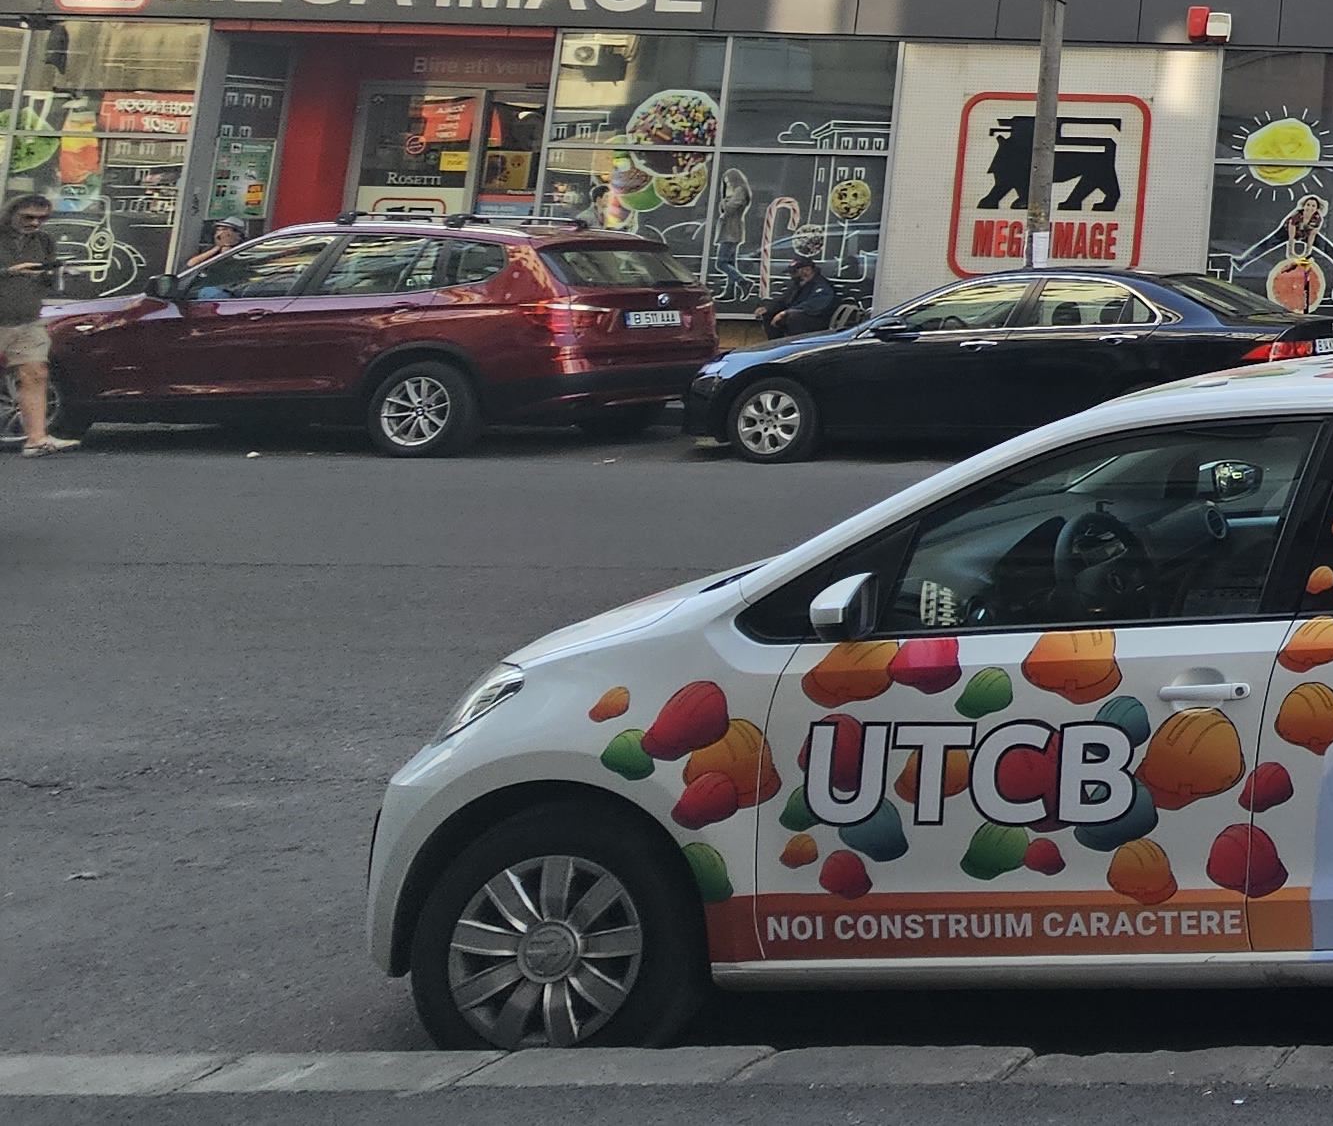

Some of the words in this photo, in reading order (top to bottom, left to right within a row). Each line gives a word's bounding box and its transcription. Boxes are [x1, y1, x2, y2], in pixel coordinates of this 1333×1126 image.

[971, 220, 1024, 258] MEG
[1049, 221, 1118, 260] MAGE
[634, 313, 642, 324] B
[645, 313, 658, 324] 511
[804, 719, 1137, 827] UTCB
[767, 916, 823, 941] NOI
[834, 913, 1033, 940] CONSTRUIM
[1043, 909, 1242, 938] CARACTERE
